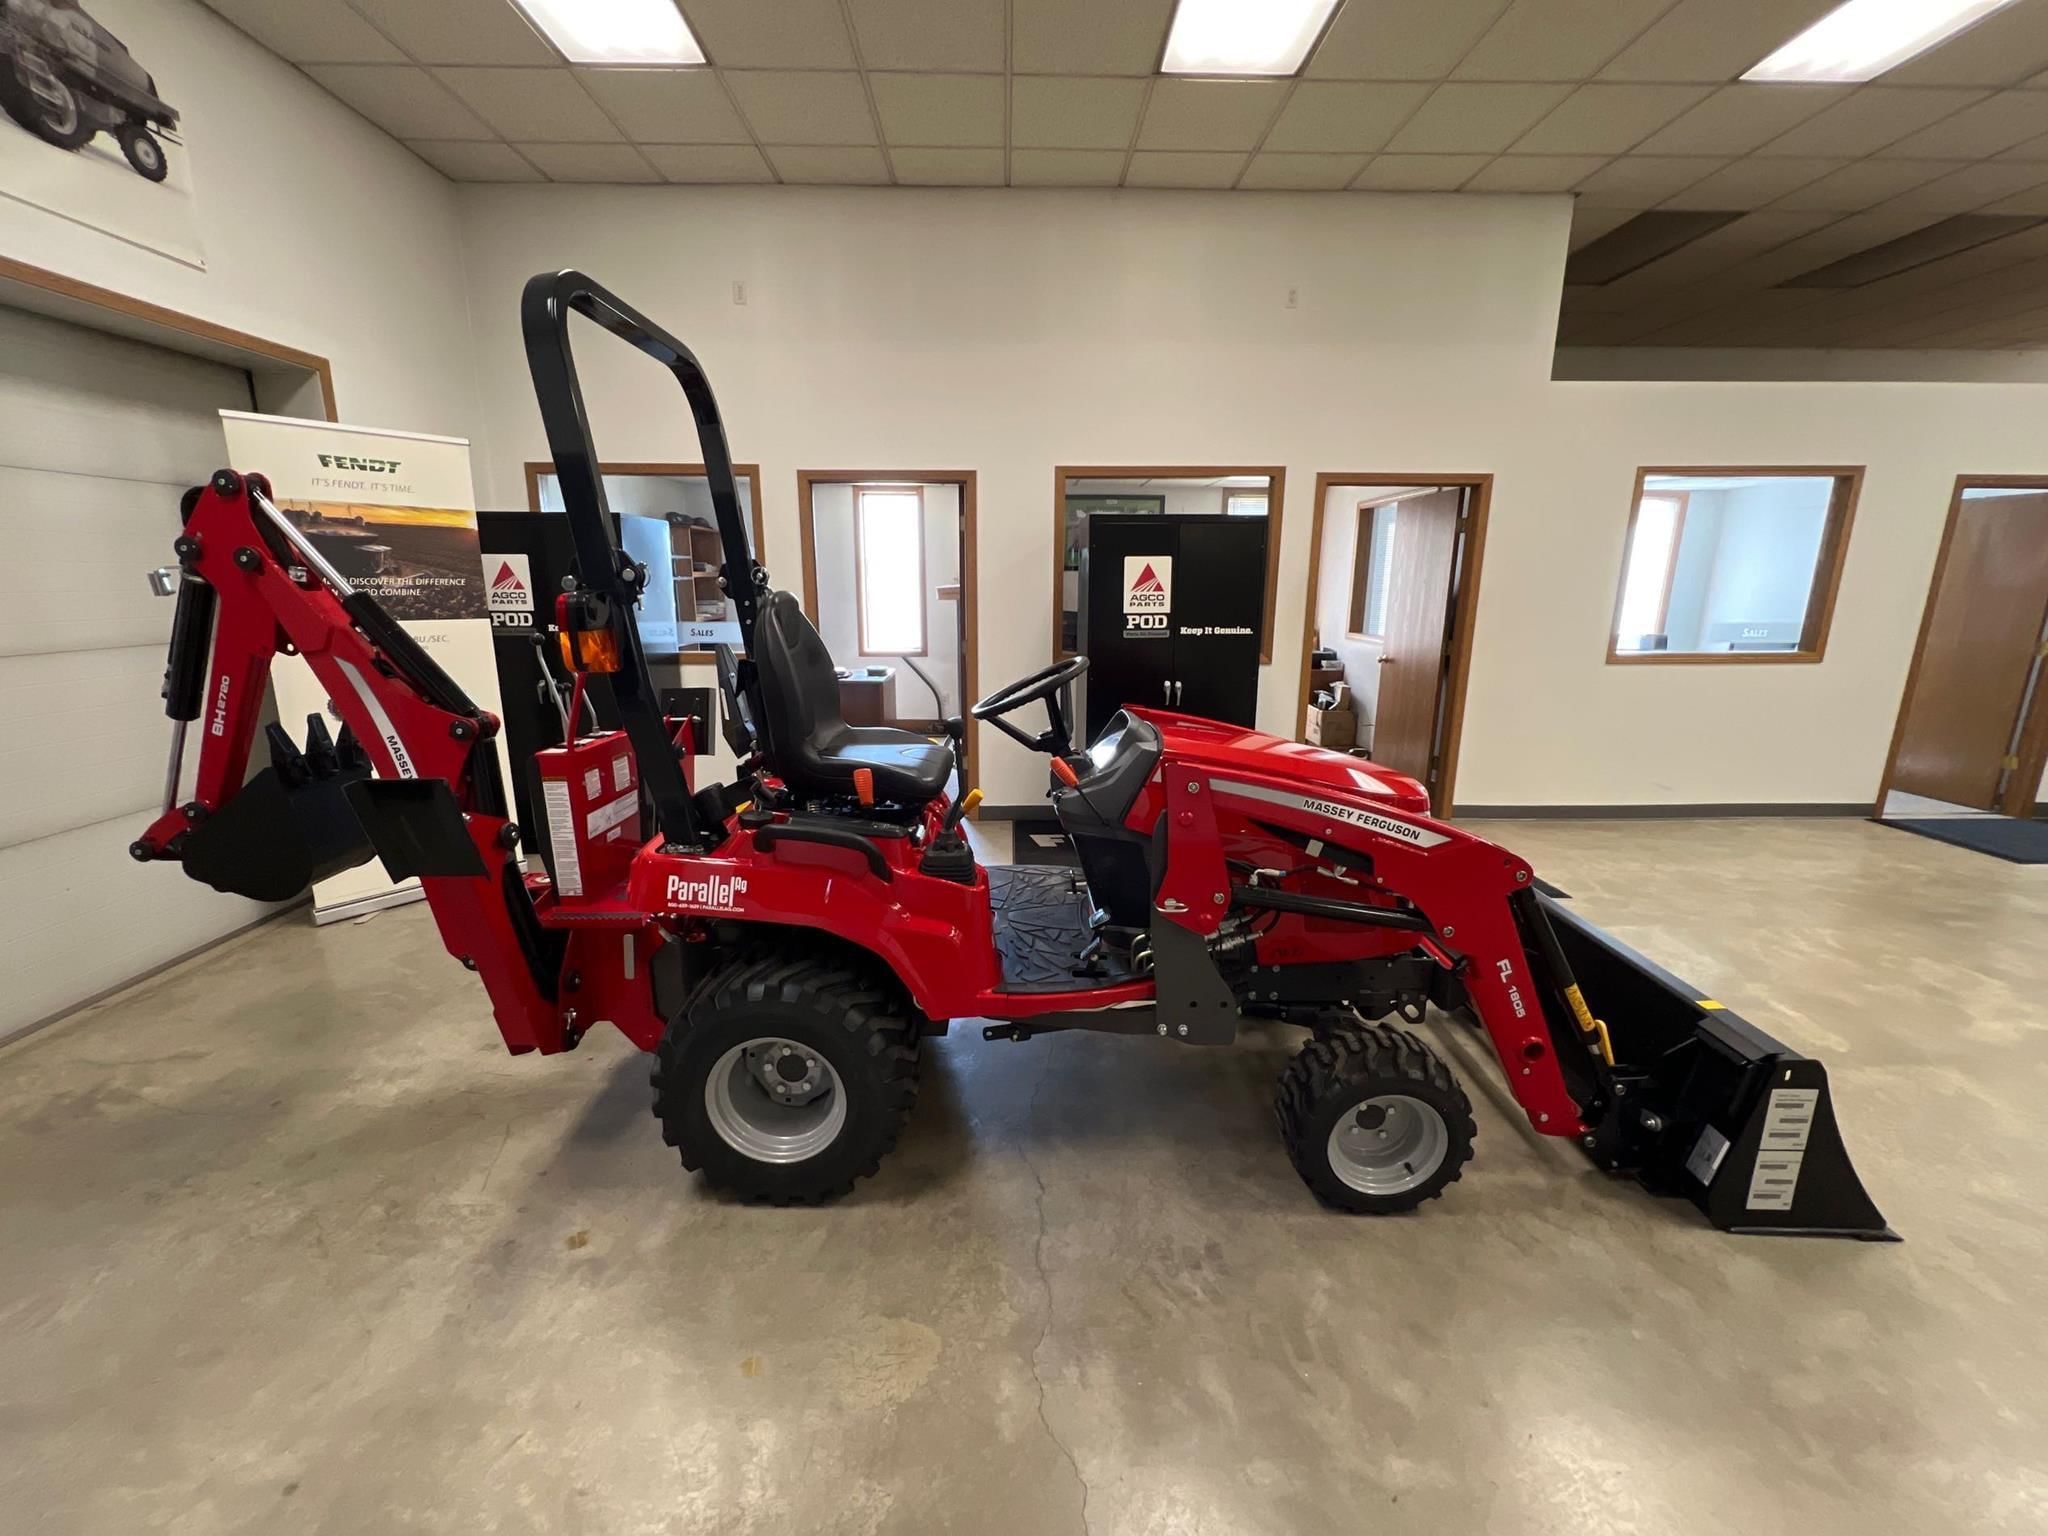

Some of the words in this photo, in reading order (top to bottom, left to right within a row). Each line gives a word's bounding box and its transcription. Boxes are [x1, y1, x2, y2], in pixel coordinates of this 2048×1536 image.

[317, 454, 402, 473] FENDT
[350, 577, 399, 586] DISCOVER
[399, 577, 415, 586] THE
[415, 578, 466, 586] DIFFERENCE
[379, 588, 421, 596] COMBINE
[491, 612, 533, 627] POD
[1126, 615, 1168, 629] POD
[1180, 627, 1203, 636] Keep
[1205, 627, 1213, 635] It
[1303, 799, 1354, 819] MASSEY
[1356, 813, 1421, 841] FERGUSON
[1496, 958, 1513, 984] FL
[1508, 985, 1526, 1018] 1805
